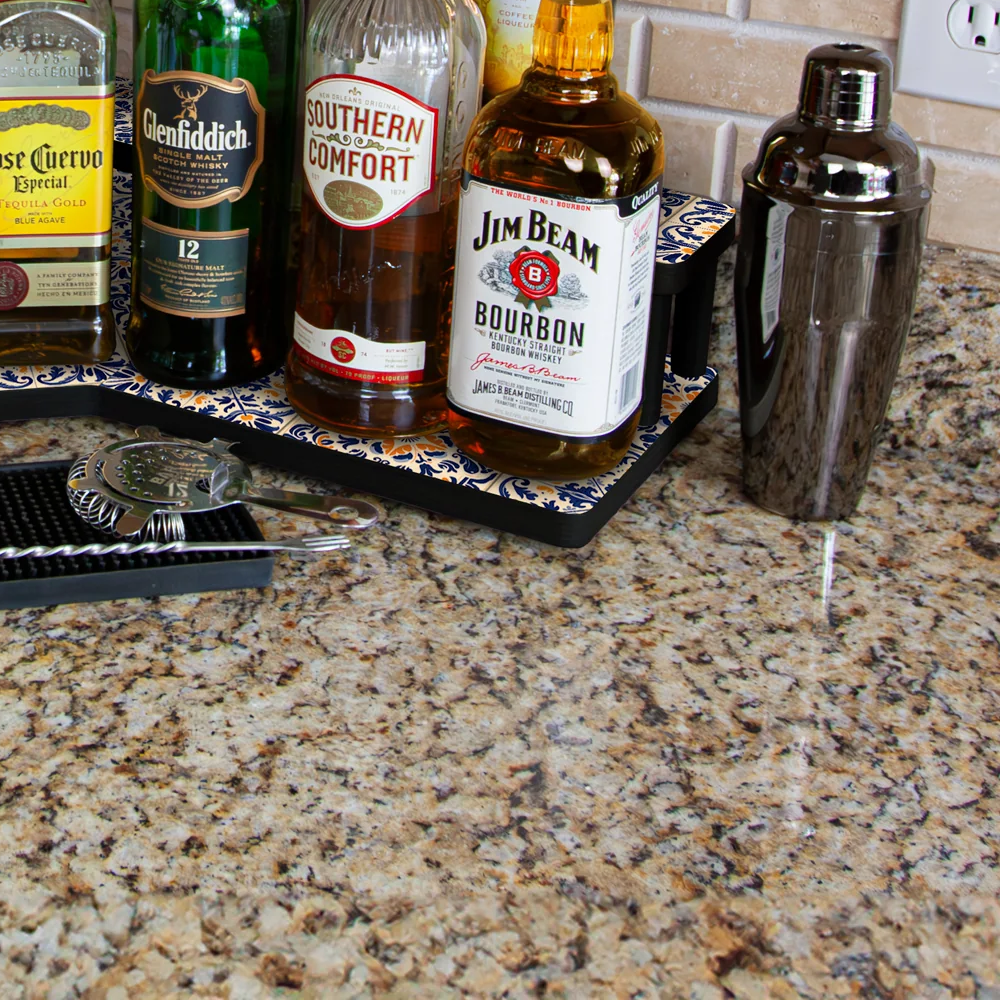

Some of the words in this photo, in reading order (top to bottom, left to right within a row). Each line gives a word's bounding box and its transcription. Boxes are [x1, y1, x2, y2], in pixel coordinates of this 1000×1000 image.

[499, 9, 535, 21] COFFEE
[319, 92, 331, 100] NEW
[331, 93, 363, 105] ORLEANS
[364, 99, 401, 112] ORIGINAL
[143, 107, 248, 151] Glenfiddich
[307, 98, 425, 145] SOUTHERN
[30, 142, 104, 175] Cuervo
[153, 153, 187, 167] SCOTCH
[190, 162, 229, 170] WHISKY
[158, 147, 192, 160] SINGLE
[308, 137, 415, 183] COMFORT
[13, 175, 69, 194] Especial
[631, 181, 659, 210] QUALITY
[52, 197, 87, 208] GOLD
[490, 187, 504, 195] THE
[556, 200, 592, 212] BOURBON
[14, 217, 36, 225] BLUE
[37, 216, 65, 224] AGAVE
[178, 239, 200, 260] 12
[473, 210, 524, 252] JIM
[526, 208, 602, 275] BEAM
[528, 266, 542, 282] B
[475, 300, 585, 348] BOURBON
[488, 330, 527, 349] KENTUCKY
[529, 340, 566, 356] STRAIGHT
[491, 341, 526, 357] BOURBON
[528, 350, 562, 365] WHISKEY
[470, 352, 518, 371] James
[536, 367, 581, 382] Beam
[472, 379, 497, 395] JAMES
[504, 386, 524, 398] BEAM
[524, 391, 562, 412] DISTILLING
